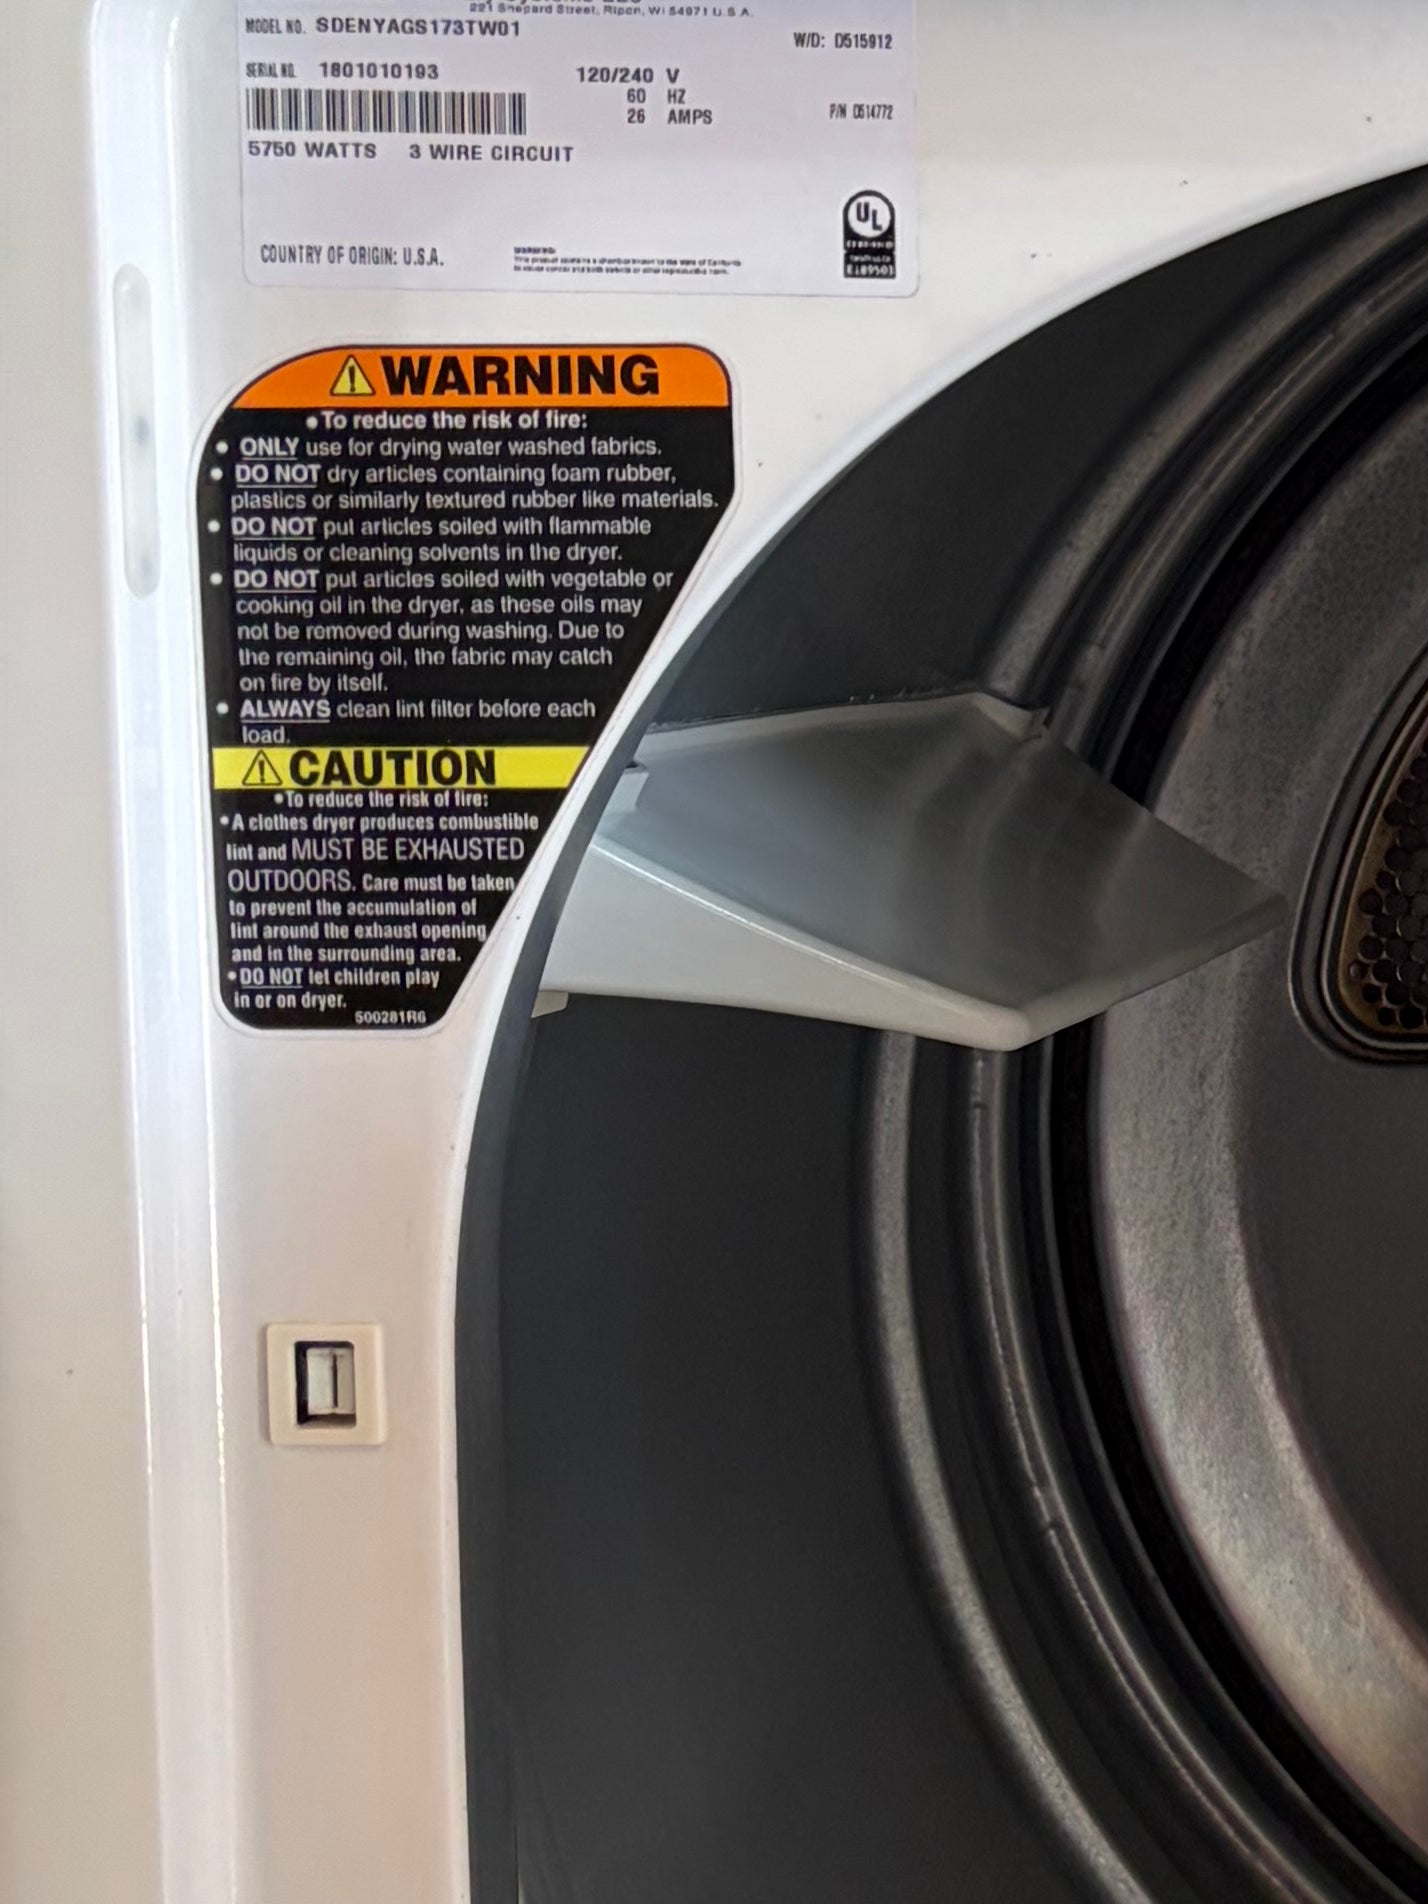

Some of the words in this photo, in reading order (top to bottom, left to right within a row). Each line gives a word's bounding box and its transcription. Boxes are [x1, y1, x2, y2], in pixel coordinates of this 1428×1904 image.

[794, 32, 824, 48] W/D:
[835, 33, 892, 49] D515912
[320, 62, 438, 80] 1801010193
[577, 67, 653, 83] 120/240
[666, 68, 680, 83] V
[627, 88, 646, 103] 60
[668, 89, 686, 104] HZ
[628, 108, 645, 123] 26
[668, 109, 712, 124] AMPS
[305, 142, 376, 158] WATTS
[410, 144, 421, 159] 3
[429, 144, 482, 160] WIRE
[491, 146, 573, 162] CIRCUIT
[856, 202, 883, 231] UL
[261, 244, 322, 264] COUNTRY
[328, 246, 344, 264] OF
[349, 246, 397, 265] ORIGIN:
[404, 248, 444, 266] U.S.A.
[380, 354, 659, 396] WARNING
[240, 437, 299, 458] ONLY
[306, 442, 342, 456] use
[348, 438, 373, 456] for
[380, 438, 441, 458] drying
[448, 439, 502, 455] water
[508, 436, 585, 455] washed
[592, 437, 661, 455] fabrics.
[236, 464, 268, 485] DO
[275, 464, 321, 485] NOT
[328, 465, 358, 485] dry
[366, 464, 437, 482] articles
[444, 464, 545, 485] containing
[552, 464, 600, 482] foam
[607, 464, 676, 483] rubber,
[231, 491, 306, 513] plastics
[312, 495, 332, 508] or
[339, 491, 419, 512] similarly
[426, 490, 505, 508] textured
[512, 490, 576, 508] rubber
[583, 490, 615, 507] like
[622, 489, 718, 508] materials.
[290, 748, 496, 787] CAUTION
[232, 814, 244, 830] A
[249, 814, 308, 830] clothes
[313, 814, 355, 833] dryer
[360, 813, 434, 833] produces
[440, 813, 538, 830] combustible
[226, 843, 253, 860] lint
[258, 844, 286, 860] and
[292, 838, 354, 860] MUST
[362, 838, 388, 860] BE
[396, 837, 524, 860] EXHAUSTED
[228, 869, 355, 892] OUTDOORS.
[363, 874, 398, 891] Care
[404, 875, 442, 891] must
[448, 874, 466, 891] be
[471, 874, 515, 891] taken
[240, 967, 264, 986] DO
[270, 967, 303, 986] NOT
[309, 968, 330, 984] let
[334, 968, 400, 985] children
[406, 968, 439, 986] play
